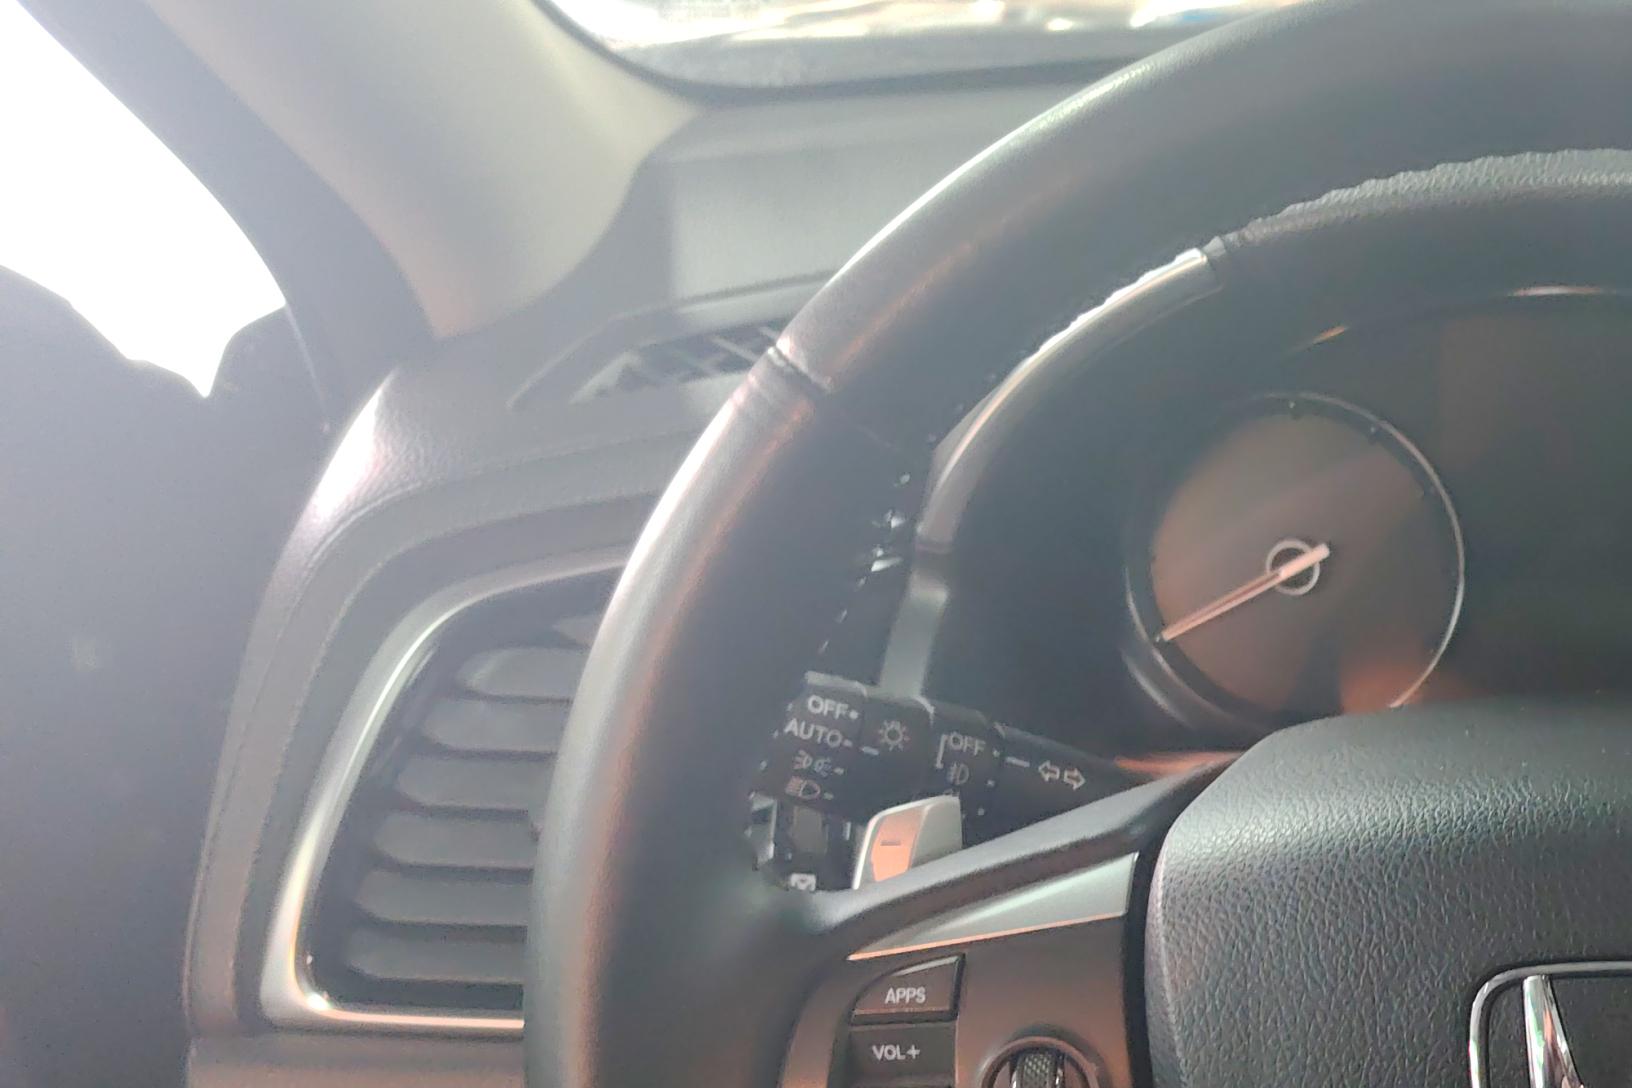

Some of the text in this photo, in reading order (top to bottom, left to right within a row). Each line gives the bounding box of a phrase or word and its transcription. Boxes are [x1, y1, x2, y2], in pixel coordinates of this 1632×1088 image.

[807, 694, 847, 720] OFF
[784, 718, 842, 748] AUTO
[949, 731, 986, 756] OFF
[885, 987, 926, 1004] APPS
